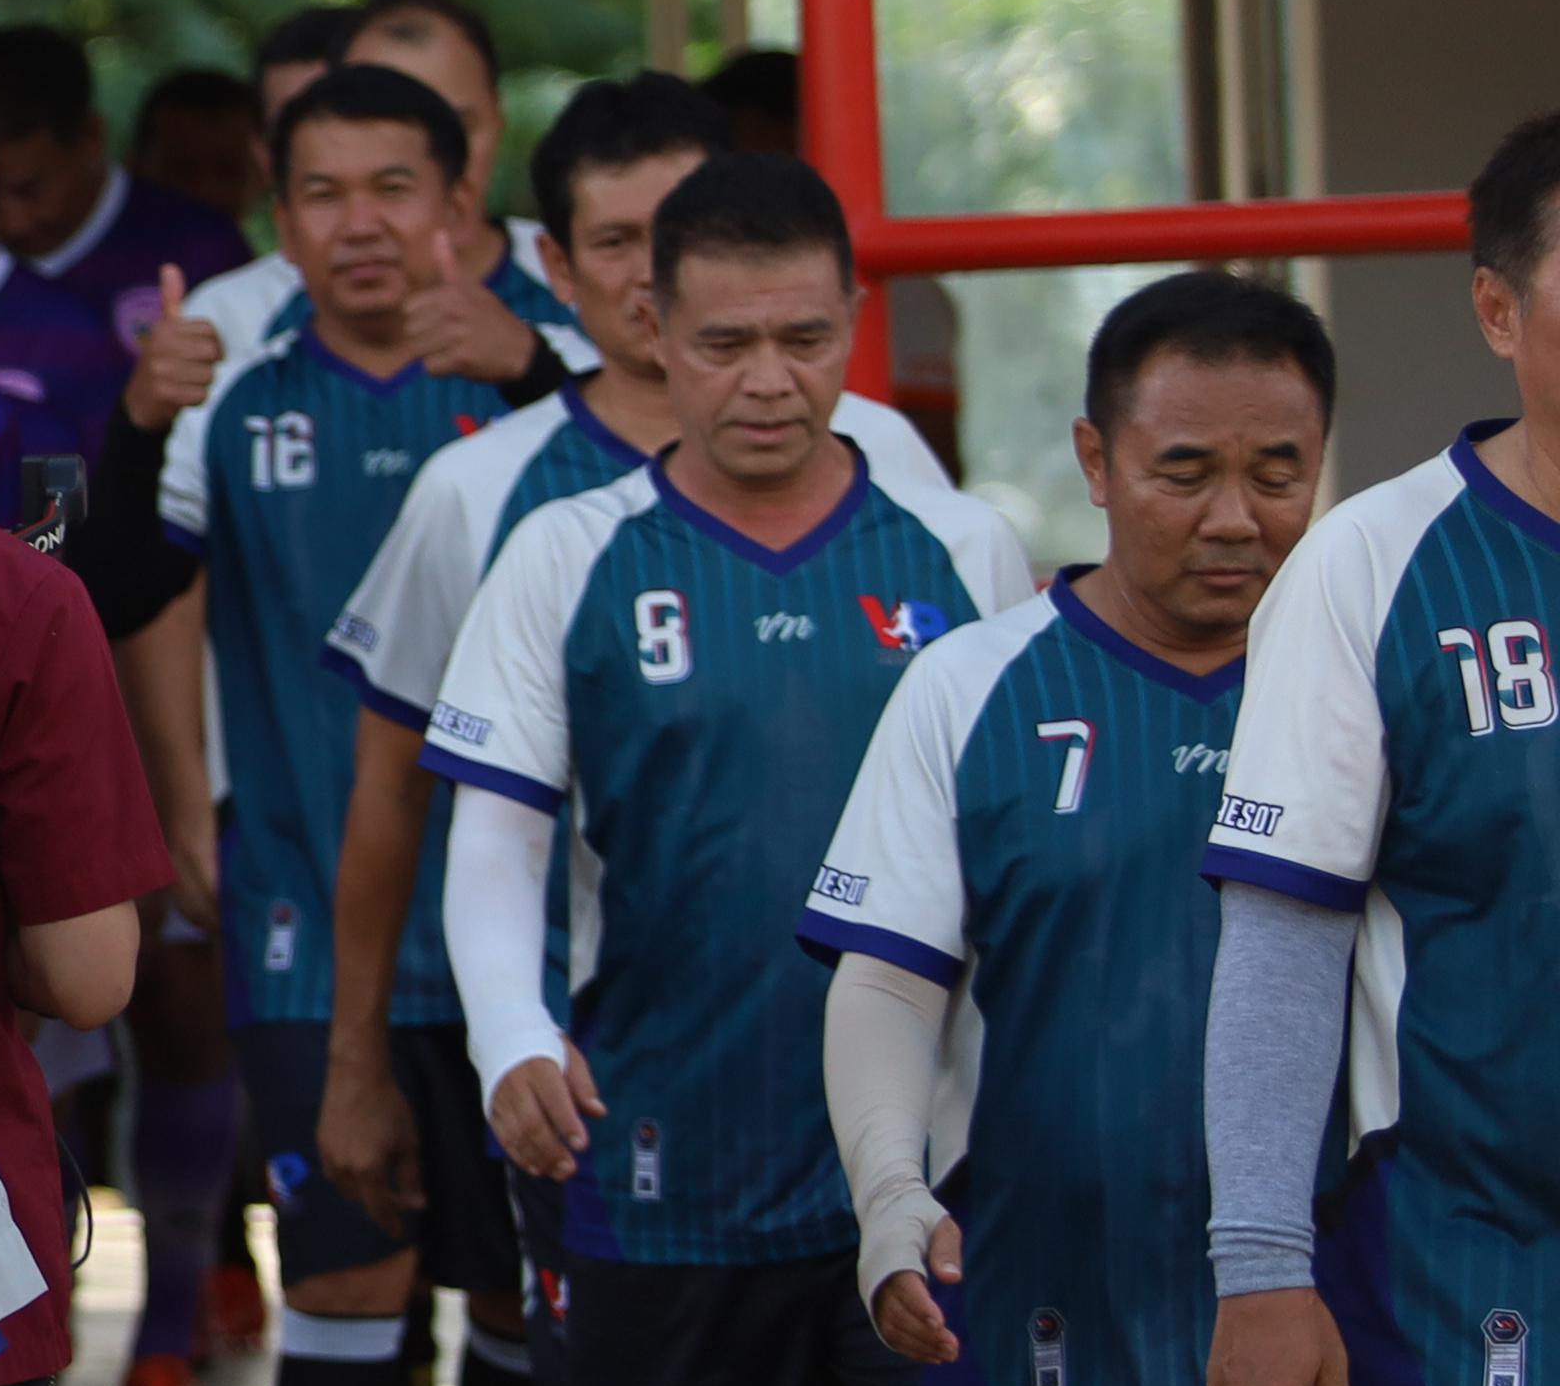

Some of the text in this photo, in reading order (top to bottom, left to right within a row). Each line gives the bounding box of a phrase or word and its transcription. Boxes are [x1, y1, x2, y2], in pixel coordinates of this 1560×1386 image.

[634, 588, 694, 685] 8
[1437, 617, 1560, 738] 18
[1036, 717, 1096, 814] 7
